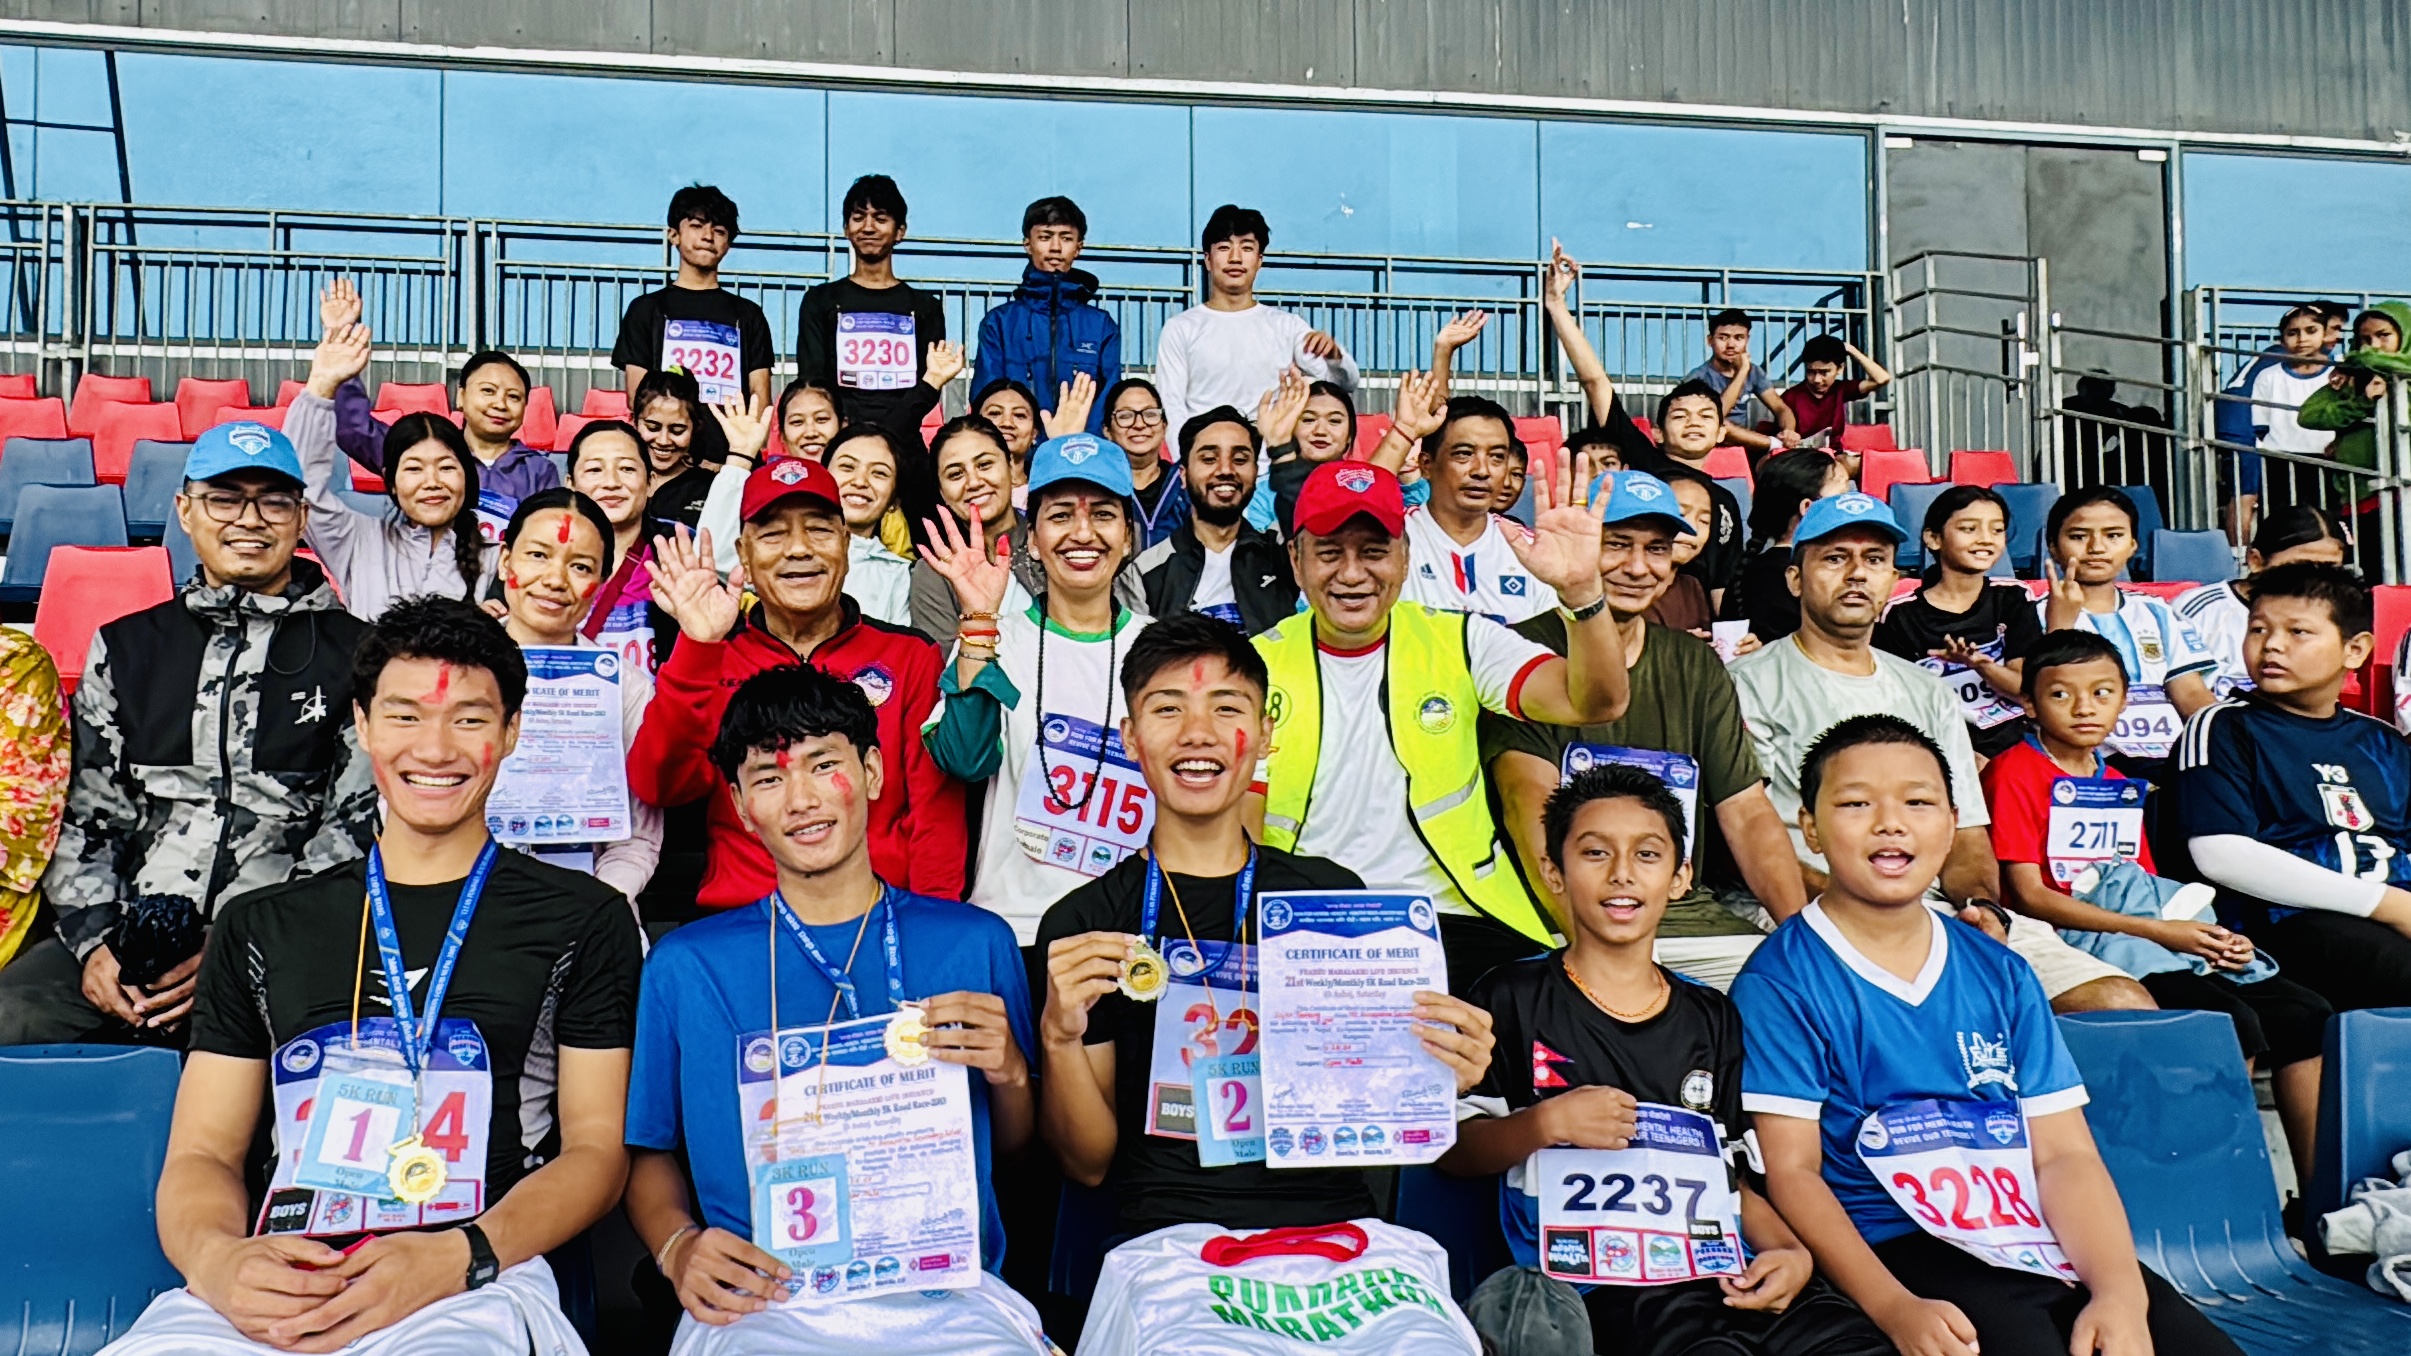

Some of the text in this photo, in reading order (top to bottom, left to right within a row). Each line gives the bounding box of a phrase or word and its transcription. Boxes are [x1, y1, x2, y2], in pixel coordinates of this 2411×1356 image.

[670, 347, 735, 380] 3232
[843, 338, 910, 367] 3230
[1043, 765, 1148, 835] 3115
[1013, 824, 1050, 842] Corporate
[2068, 821, 2118, 849] 2711
[1285, 947, 1420, 960] CERTIFICATE OF MERIT
[1285, 976, 1304, 988] 21st
[1305, 977, 1365, 989] Weekly/Monthly
[1378, 977, 1396, 986] Road
[1207, 1061, 1260, 1076] 5K RUN
[337, 1083, 400, 1104] 5K RUN
[804, 1067, 937, 1097] CERTIFICATE OF MERIT
[823, 1106, 881, 1121] Weekly/Monthly
[893, 1101, 912, 1113] Road
[1160, 1102, 1195, 1118] BOYS
[1220, 1080, 1251, 1132] 2
[342, 1108, 373, 1162] 1
[799, 1161, 829, 1179] RUN
[1562, 1172, 1707, 1223] 2237
[1892, 1164, 2041, 1231] 3228
[269, 1202, 307, 1219] BOYS
[786, 1186, 818, 1242] 3
[1690, 1224, 1719, 1236] BOYS
